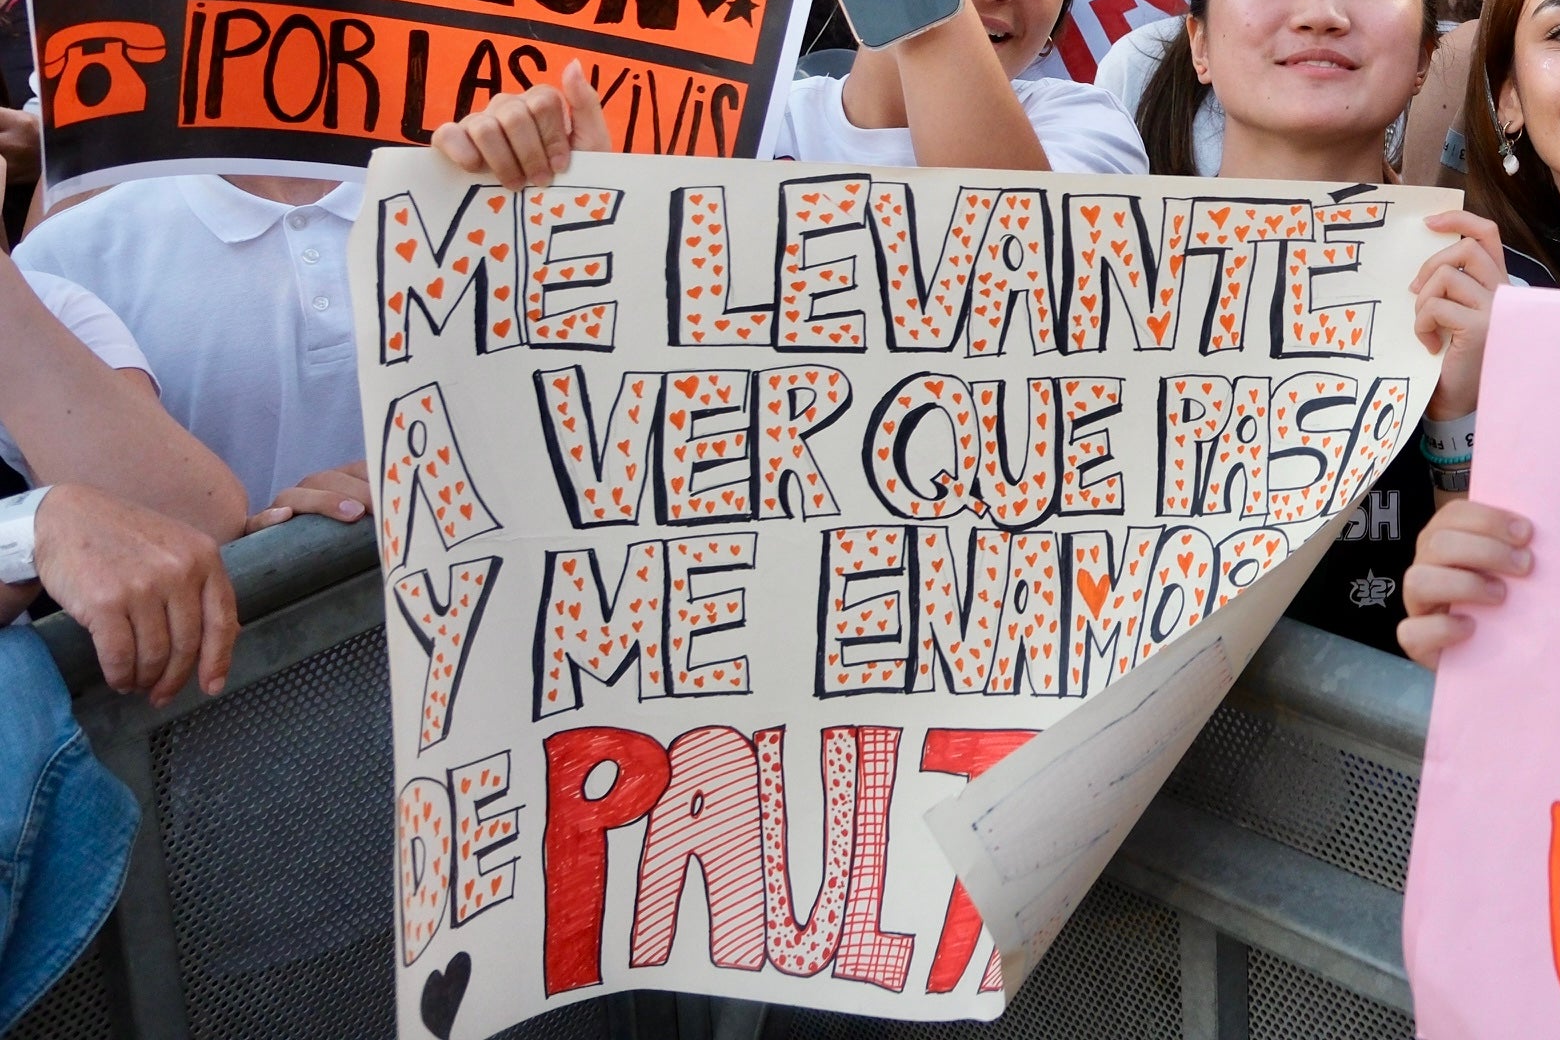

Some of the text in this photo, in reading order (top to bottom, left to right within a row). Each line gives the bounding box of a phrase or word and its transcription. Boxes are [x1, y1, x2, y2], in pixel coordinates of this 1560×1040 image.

[376, 173, 1396, 365] ME LEVANTÉ
[380, 364, 1410, 572] A VER QUE PASA
[391, 524, 1332, 757] Y ME ENAMOR
[398, 749, 526, 967] DE
